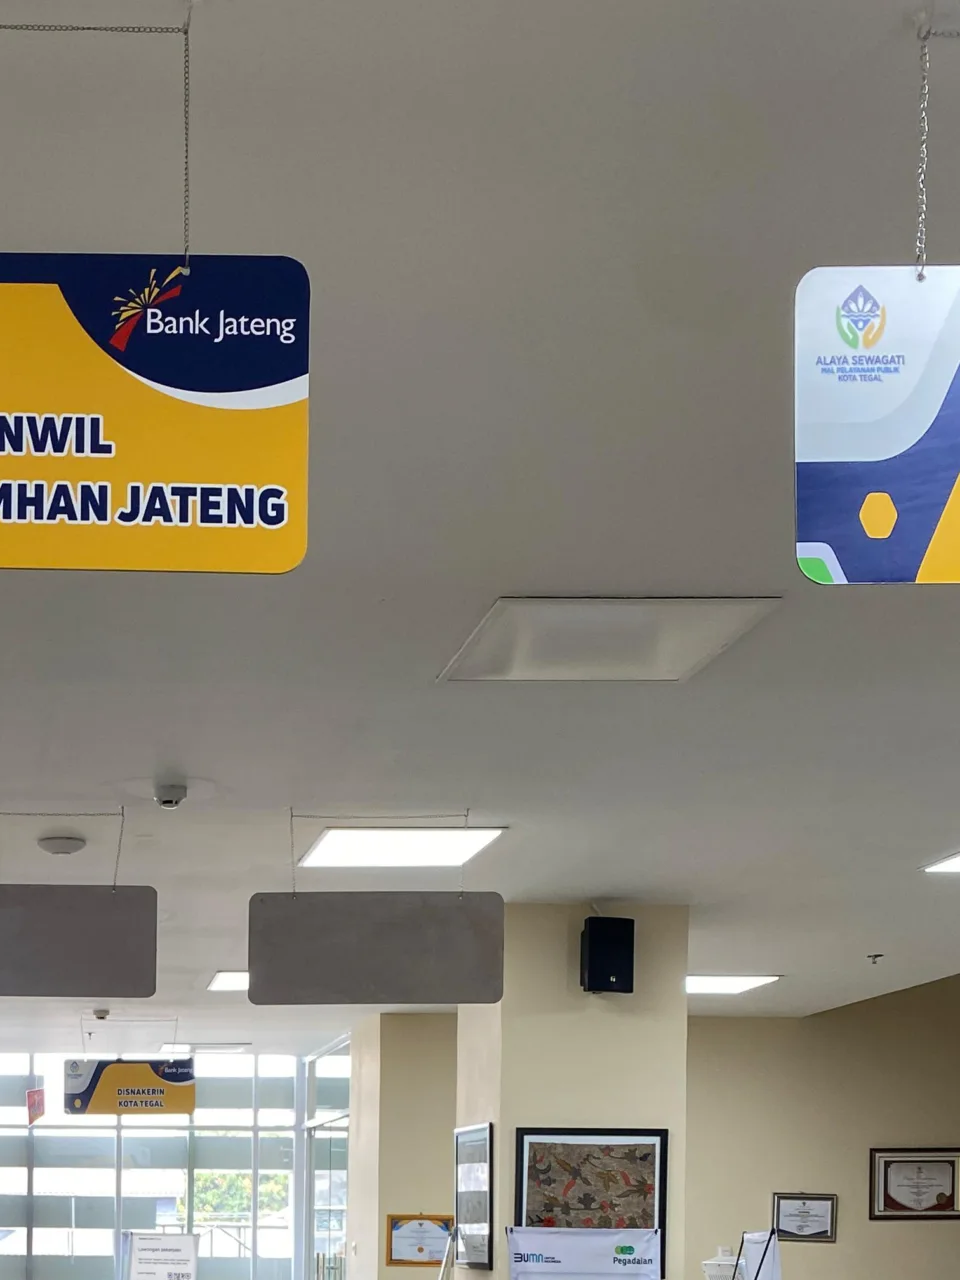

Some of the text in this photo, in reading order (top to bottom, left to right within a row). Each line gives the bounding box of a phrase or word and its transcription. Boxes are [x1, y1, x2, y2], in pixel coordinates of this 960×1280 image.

[146, 308, 297, 344] Bank Jateng
[815, 355, 905, 365] ALAYA SEWAGATI
[116, 484, 287, 527] JATENG
[117, 1088, 165, 1096] DISNAKERIN
[118, 1100, 164, 1108] KOTA TEGAL
[612, 1256, 653, 1266] Pegadaian
